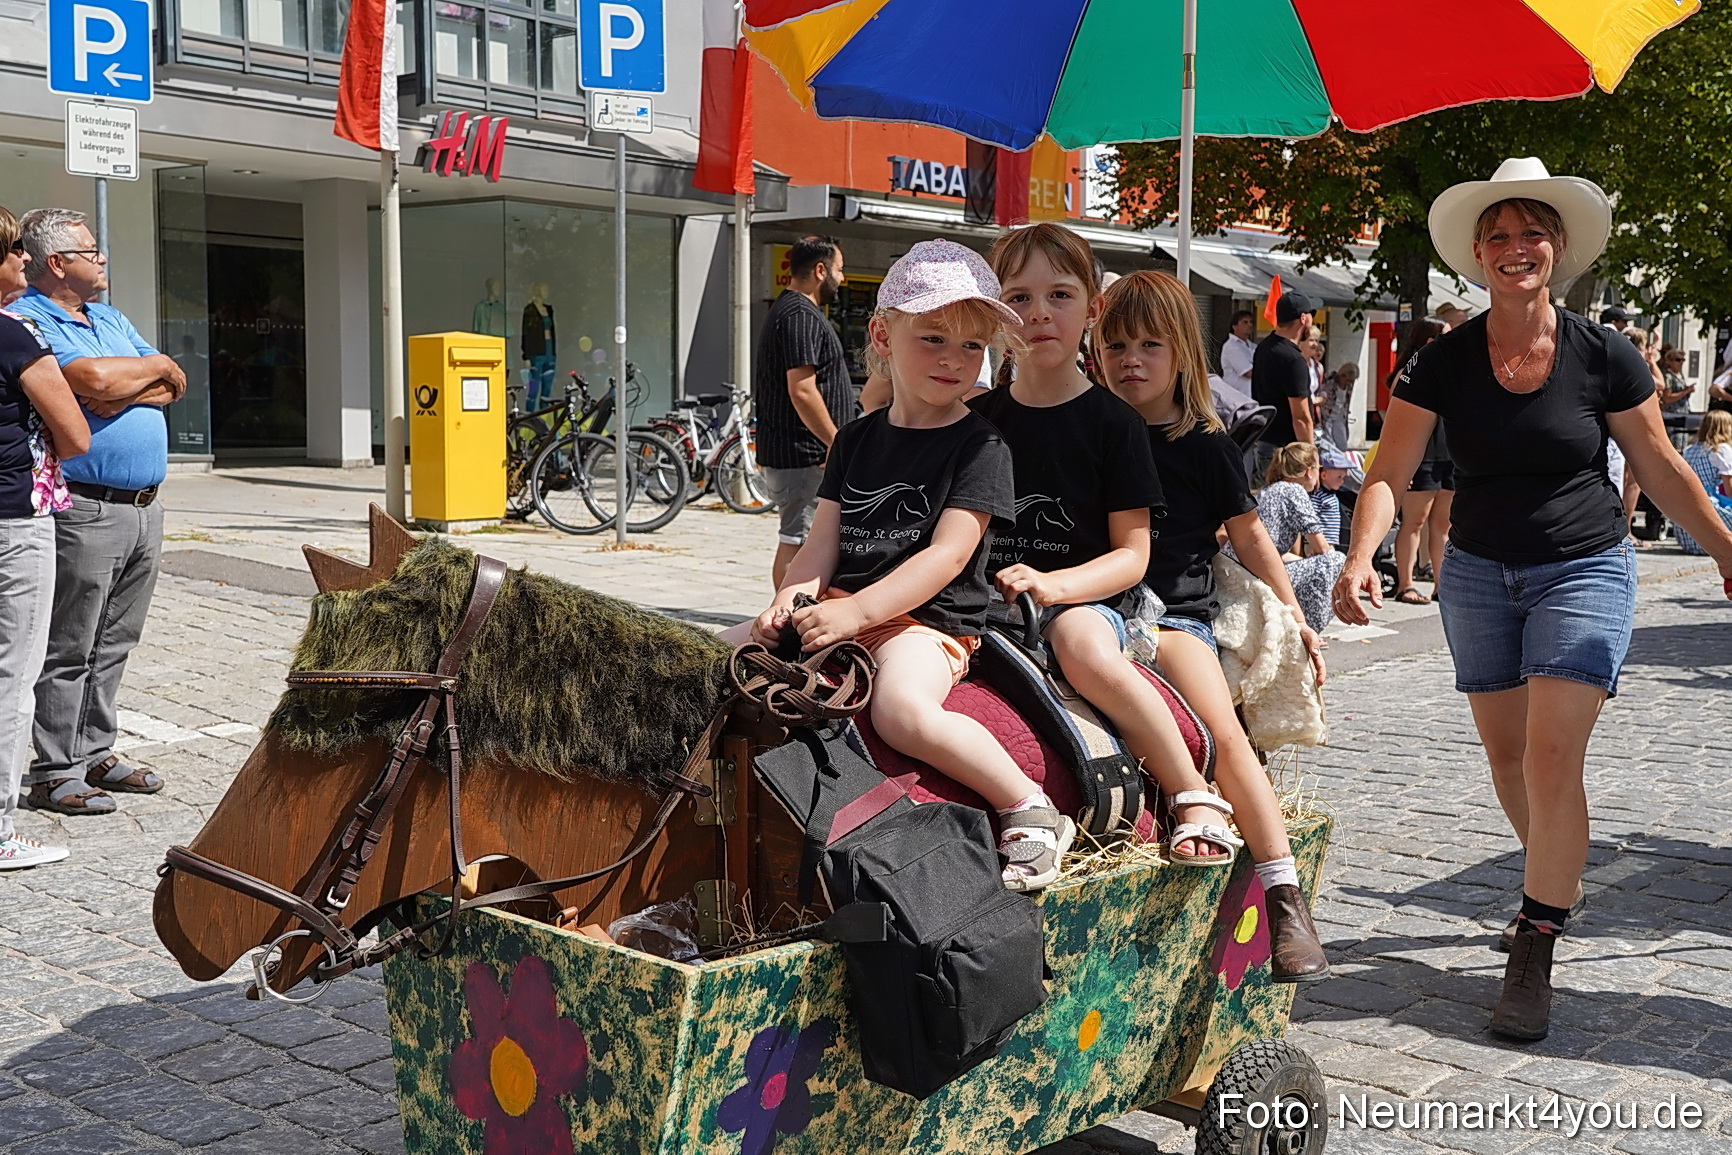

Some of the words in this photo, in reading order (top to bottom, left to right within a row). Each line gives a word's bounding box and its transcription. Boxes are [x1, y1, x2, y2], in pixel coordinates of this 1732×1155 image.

[73, 3, 127, 82] P
[599, 2, 645, 77] P
[75, 114, 132, 130] Elektrofahrzeuge
[82, 129, 111, 138] während
[113, 131, 124, 140] des
[79, 141, 125, 155] Ladevorgangs
[422, 109, 509, 183] H&M
[96, 155, 109, 164] frei
[889, 529, 921, 541] Georg
[991, 536, 1015, 547] erein
[1033, 539, 1070, 554] Georg
[1004, 552, 1025, 563] e.V.
